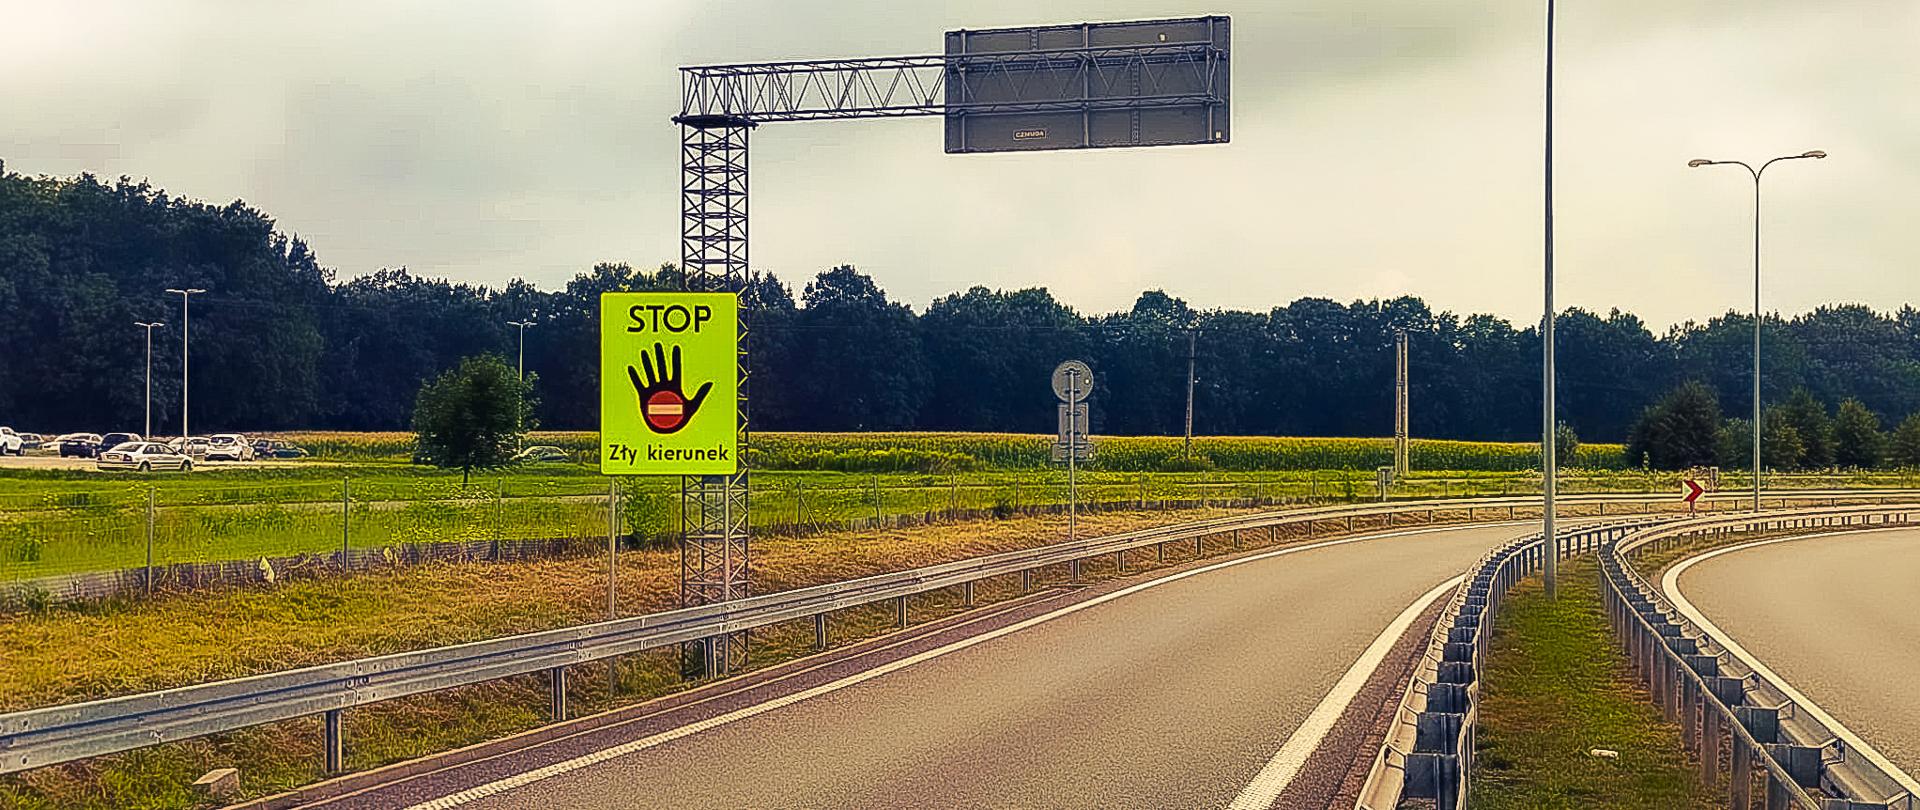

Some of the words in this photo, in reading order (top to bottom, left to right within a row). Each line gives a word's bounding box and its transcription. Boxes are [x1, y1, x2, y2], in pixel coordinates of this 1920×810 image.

[627, 305, 712, 333] STOP
[609, 444, 638, 466] Zły
[648, 444, 729, 461] kierunek
